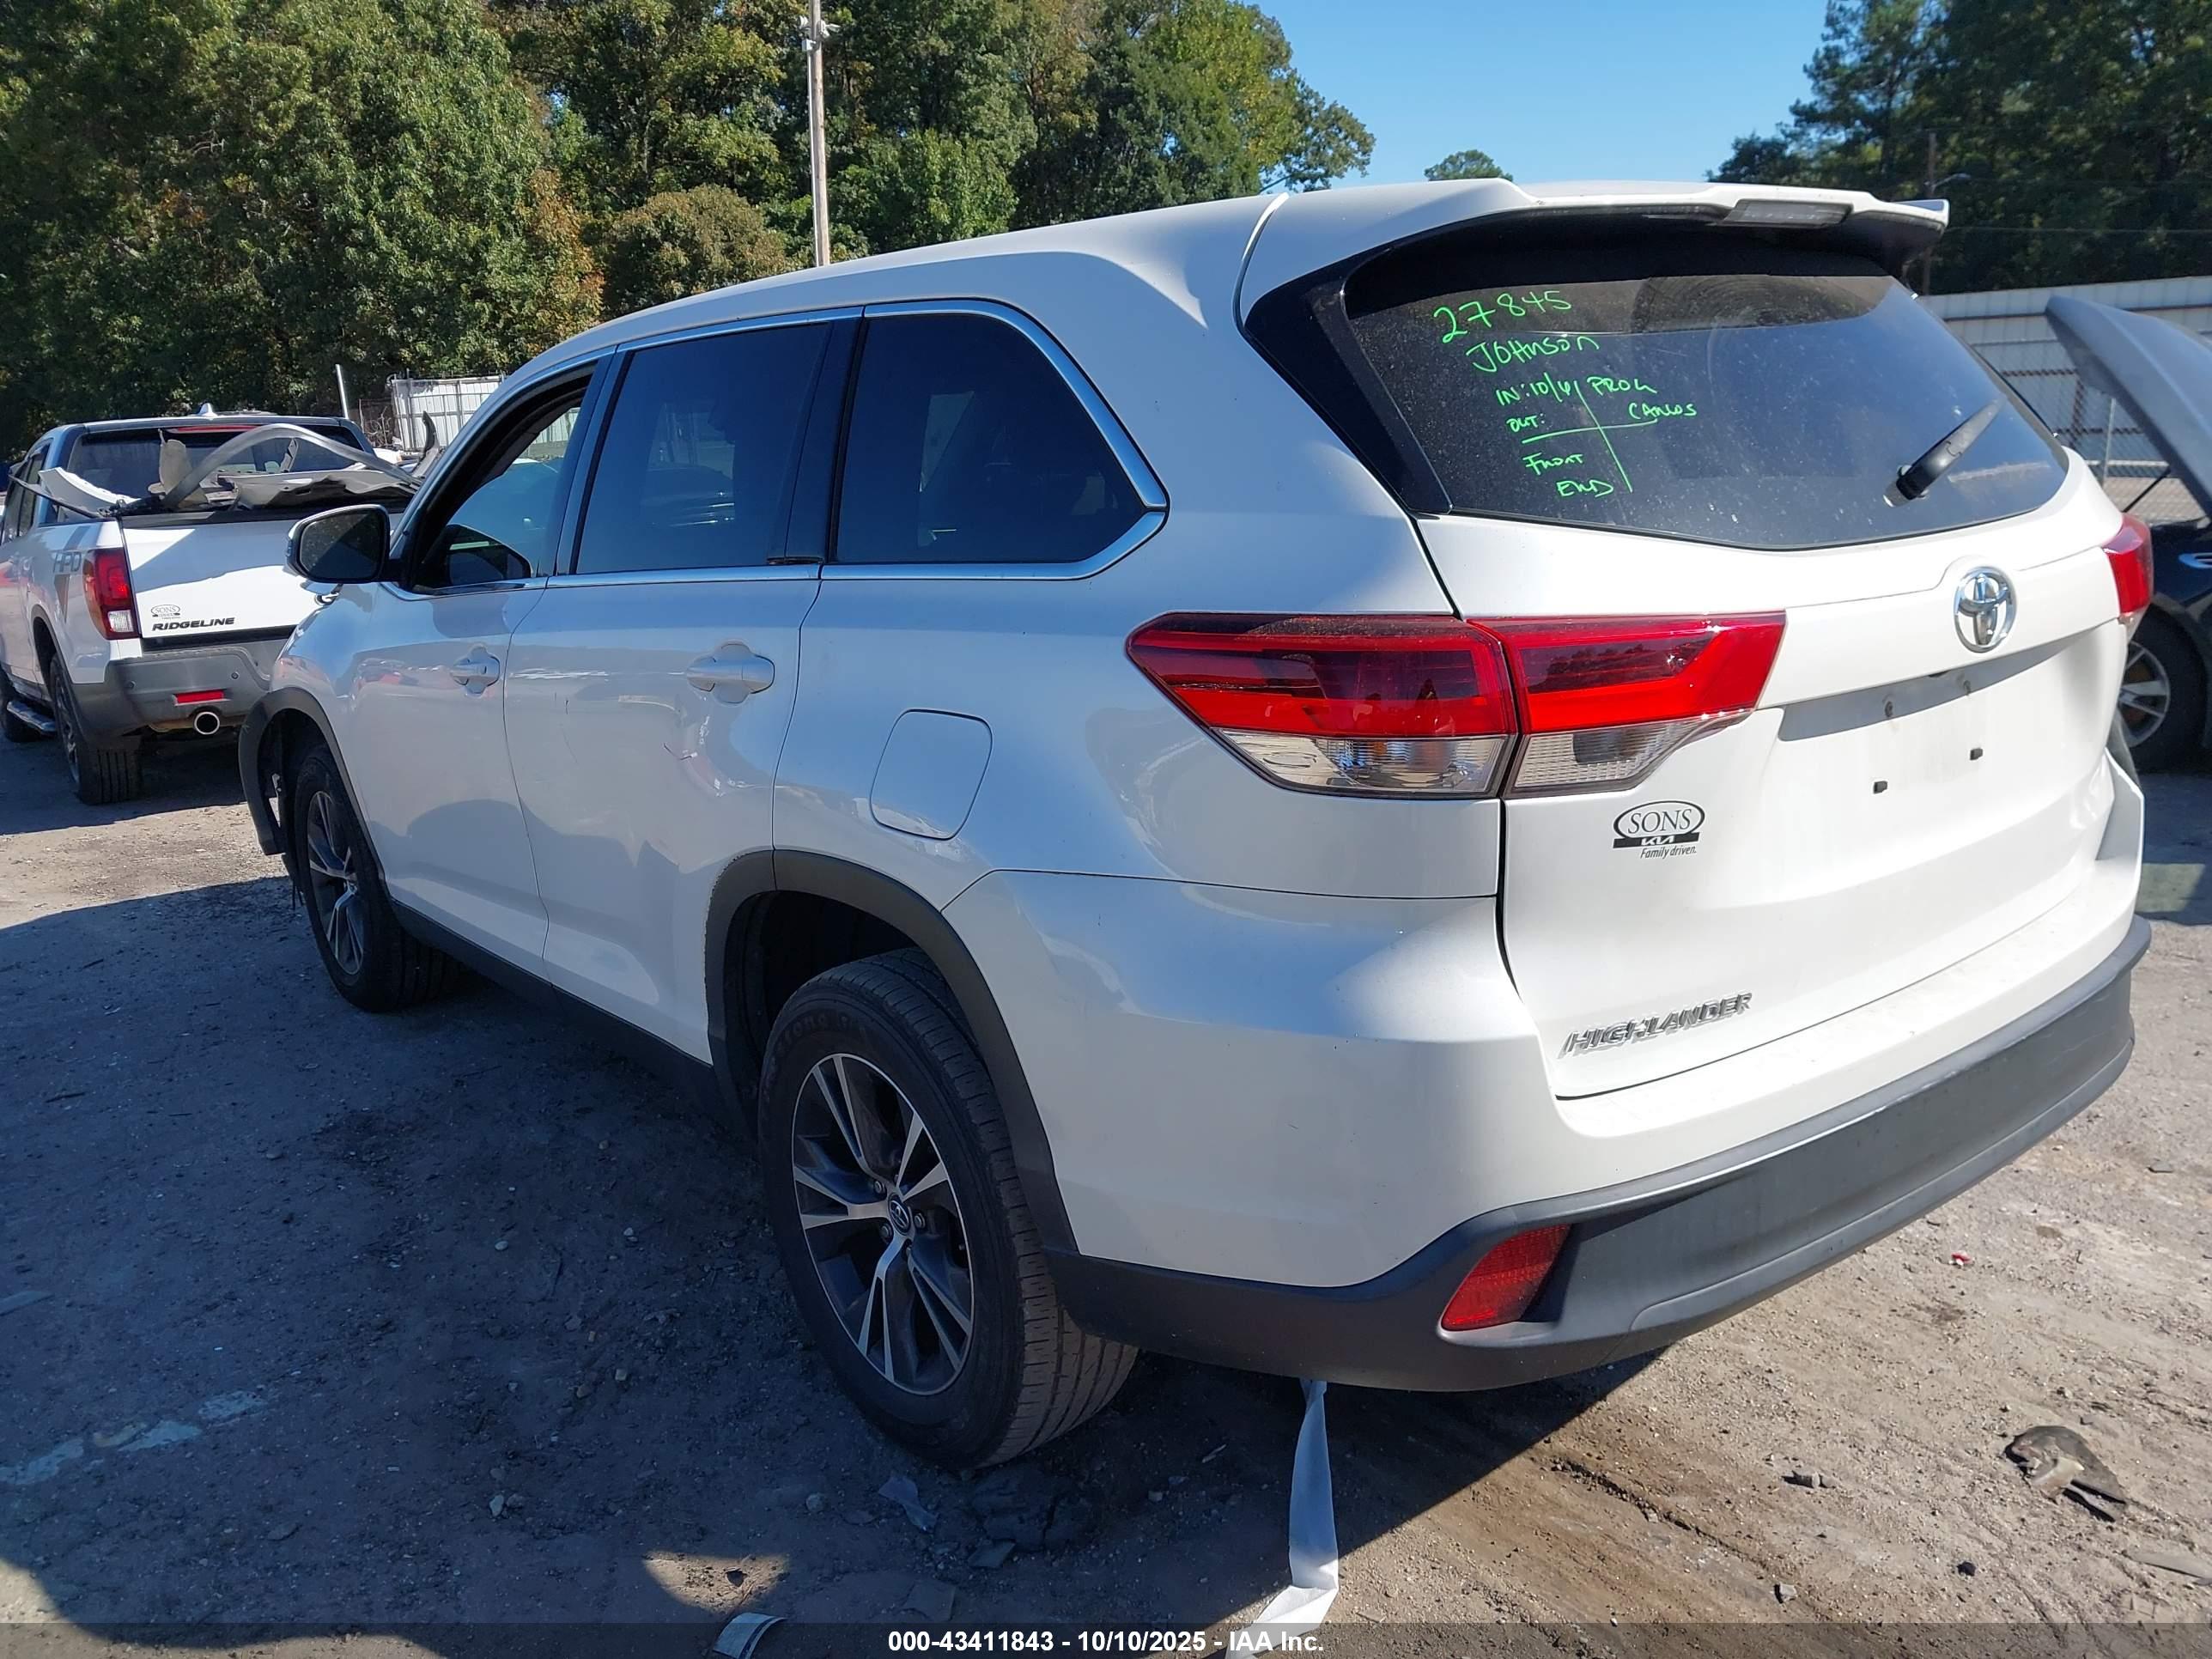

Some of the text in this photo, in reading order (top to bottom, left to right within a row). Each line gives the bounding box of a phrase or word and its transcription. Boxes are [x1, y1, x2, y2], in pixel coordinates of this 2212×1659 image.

[152, 617, 235, 631] RIDGELINE
[1627, 808, 1692, 835] SONS
[1640, 845, 1697, 860] Family driven.
[1558, 993, 1753, 1059] HIGHLANDER
